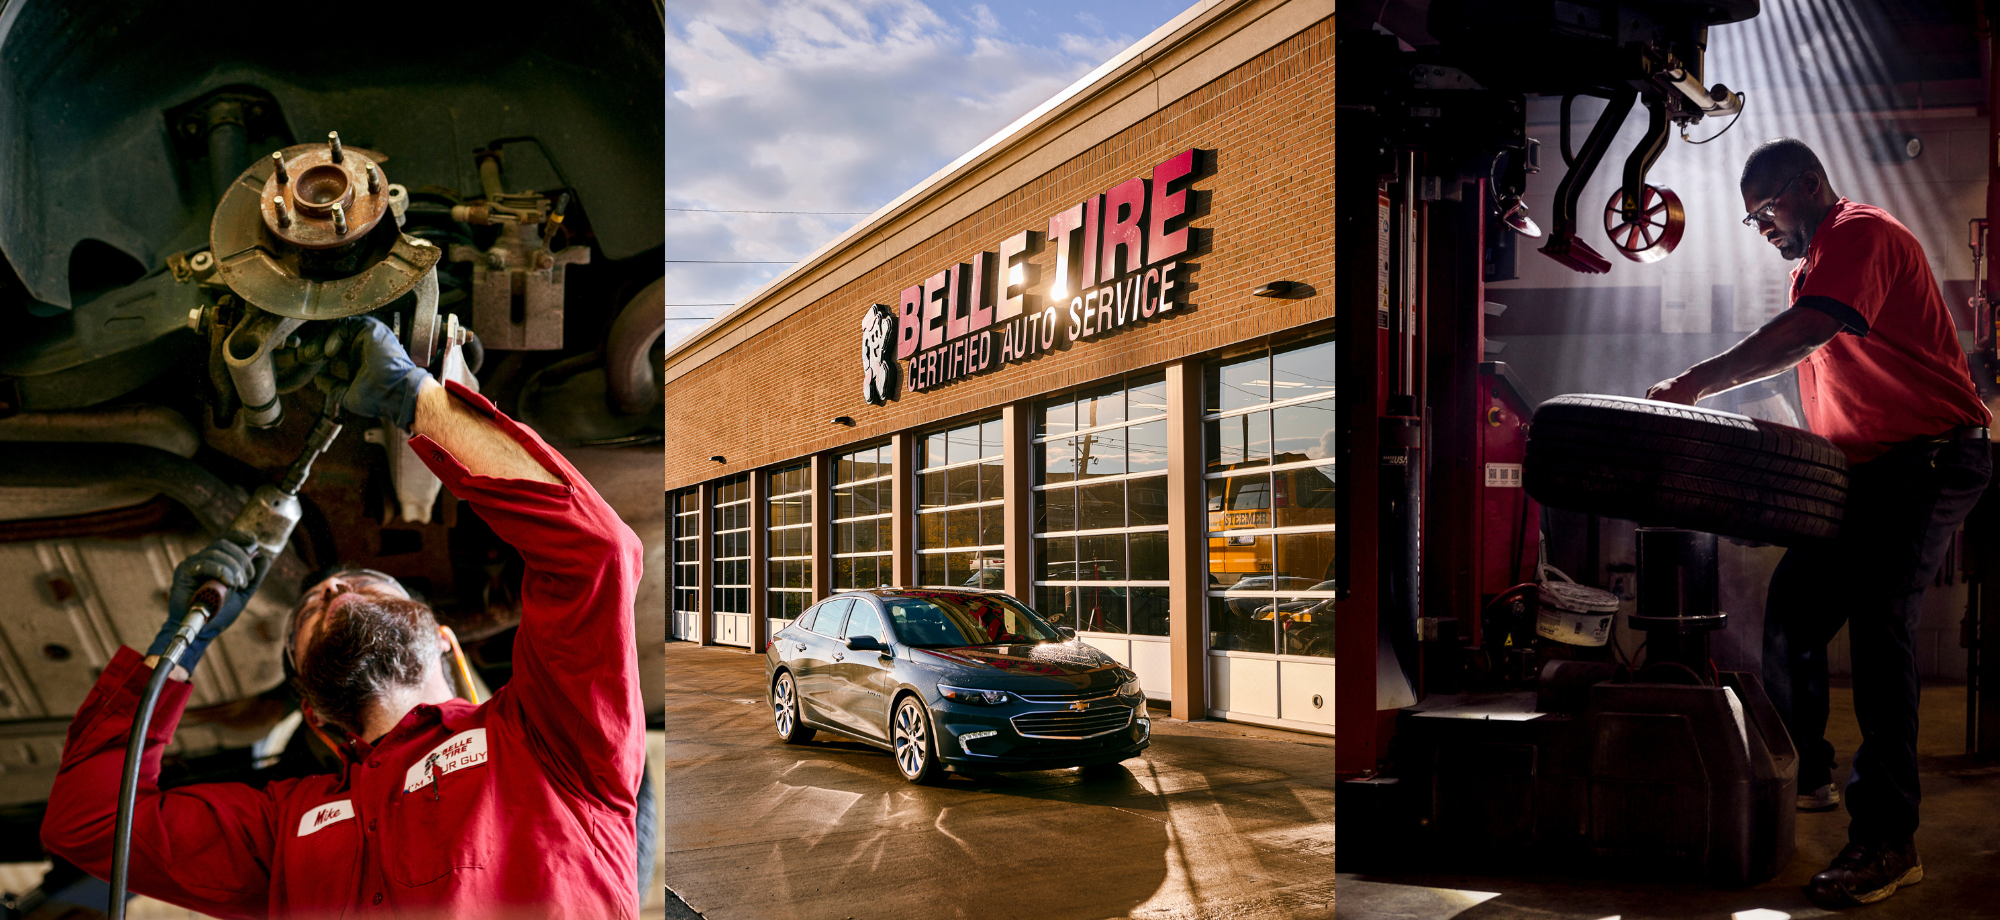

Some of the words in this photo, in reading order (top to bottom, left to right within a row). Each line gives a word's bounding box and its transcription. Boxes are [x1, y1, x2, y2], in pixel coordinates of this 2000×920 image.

[897, 230, 1029, 361] BELLE
[1048, 148, 1197, 301] TIRE
[907, 330, 992, 393] CERTIFIED
[1000, 306, 1057, 364] AUTO
[1068, 261, 1178, 342] SERVICE
[1395, 455, 1408, 465] USA
[1225, 512, 1268, 526] STEEMER
[442, 737, 473, 756] BELLE
[445, 745, 468, 760] TIRE
[408, 780, 424, 792] I'M
[460, 751, 487, 766] GUY
[314, 807, 342, 827] Mike
